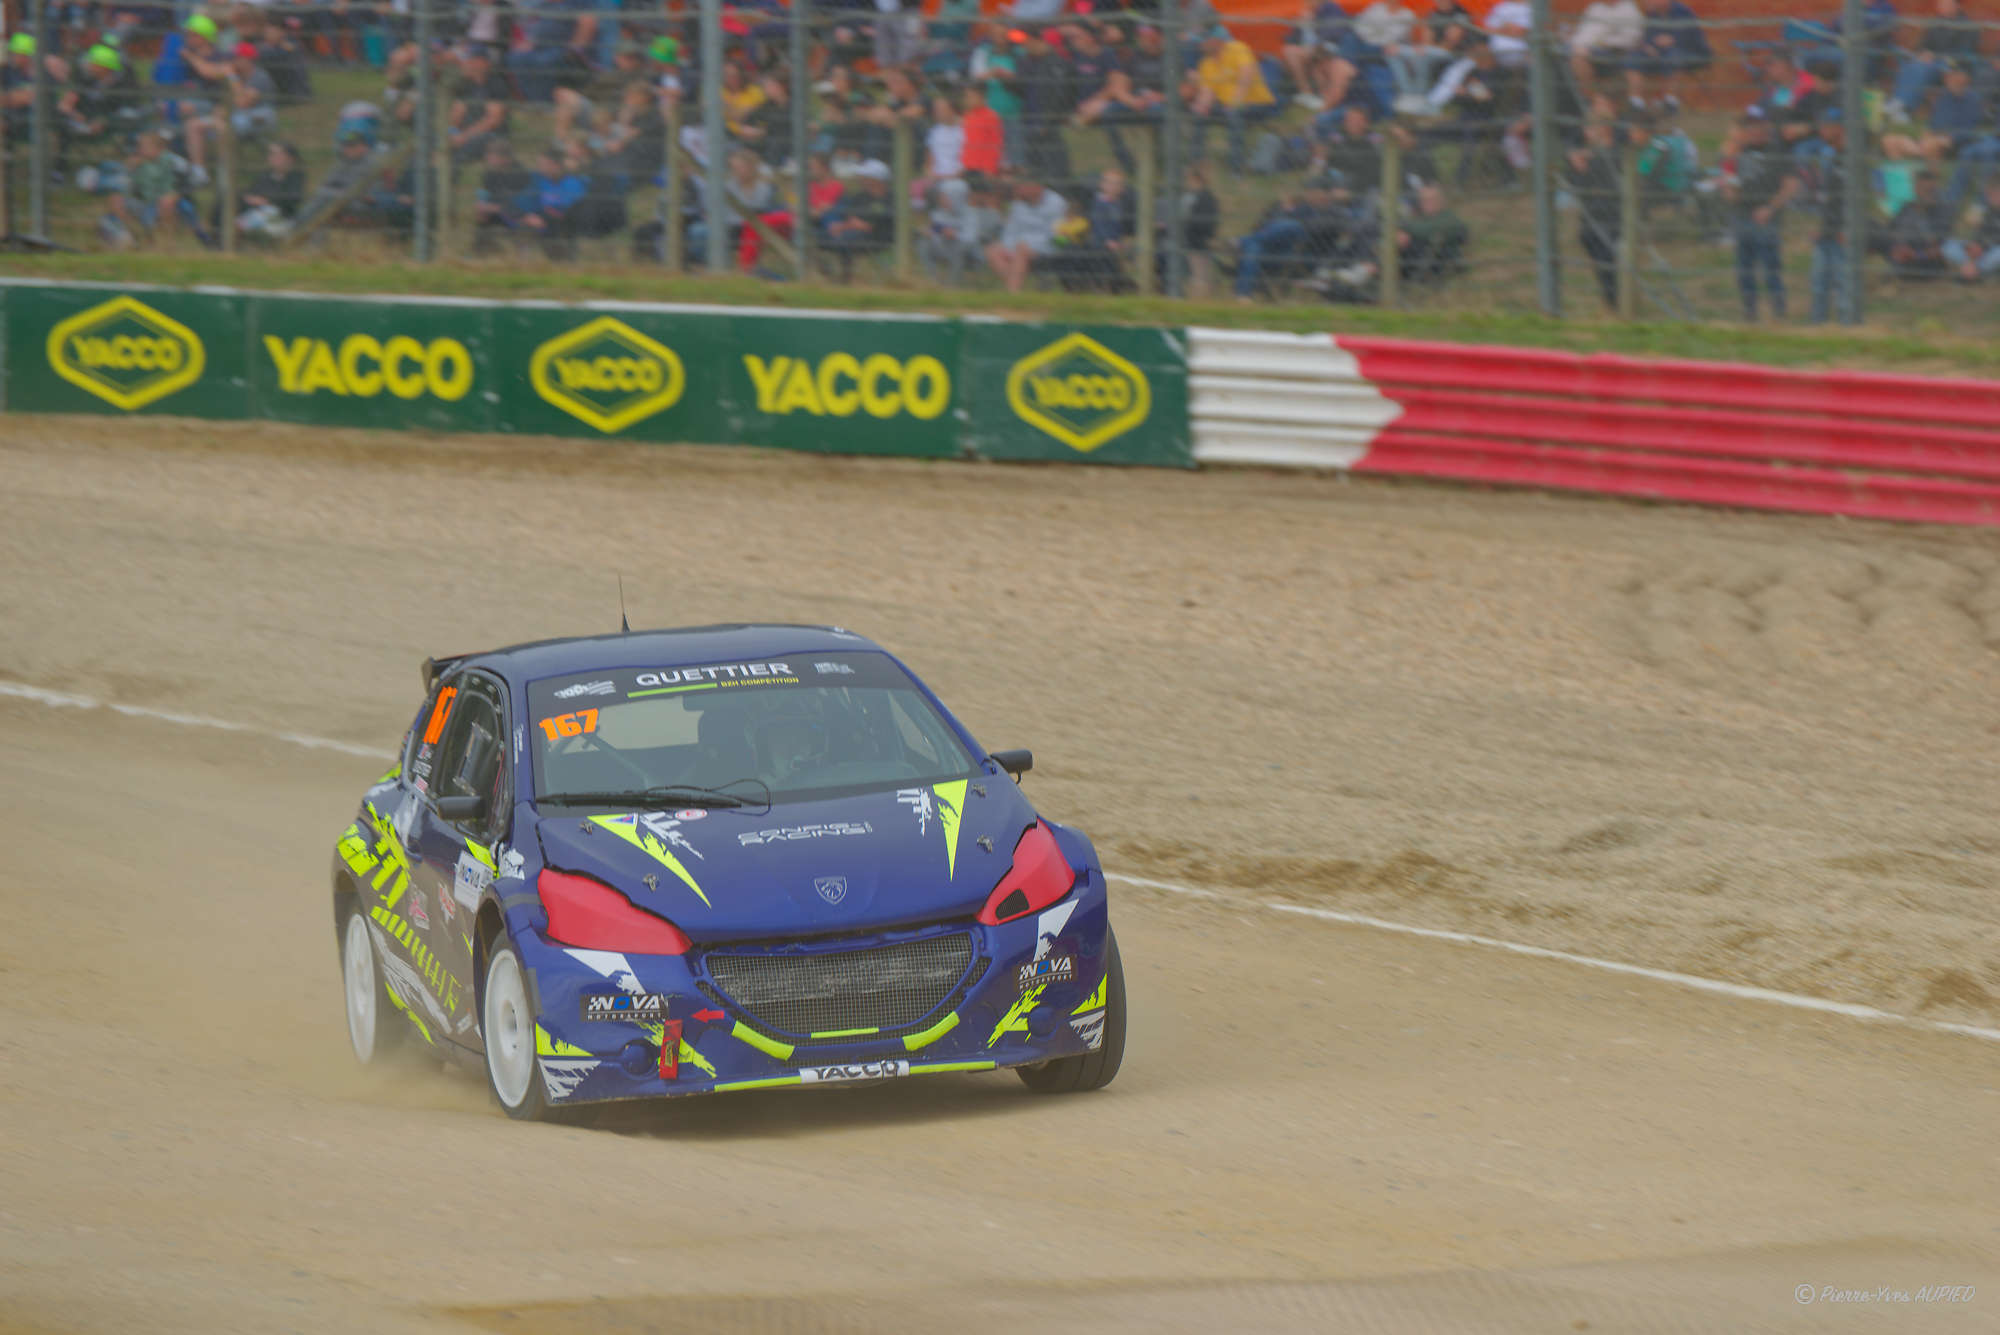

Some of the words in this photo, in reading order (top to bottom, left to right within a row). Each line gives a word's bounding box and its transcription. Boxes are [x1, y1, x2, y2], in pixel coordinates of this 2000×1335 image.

[72, 334, 182, 371] YACCO
[264, 333, 473, 402] YACCO
[554, 355, 663, 393] YACCO
[743, 351, 950, 420] YACCO
[1030, 373, 1132, 411] YACCO
[635, 662, 793, 687] QUETTIER
[538, 707, 599, 742] 167
[1019, 957, 1072, 980] NOVA
[589, 995, 661, 1011] NOVA
